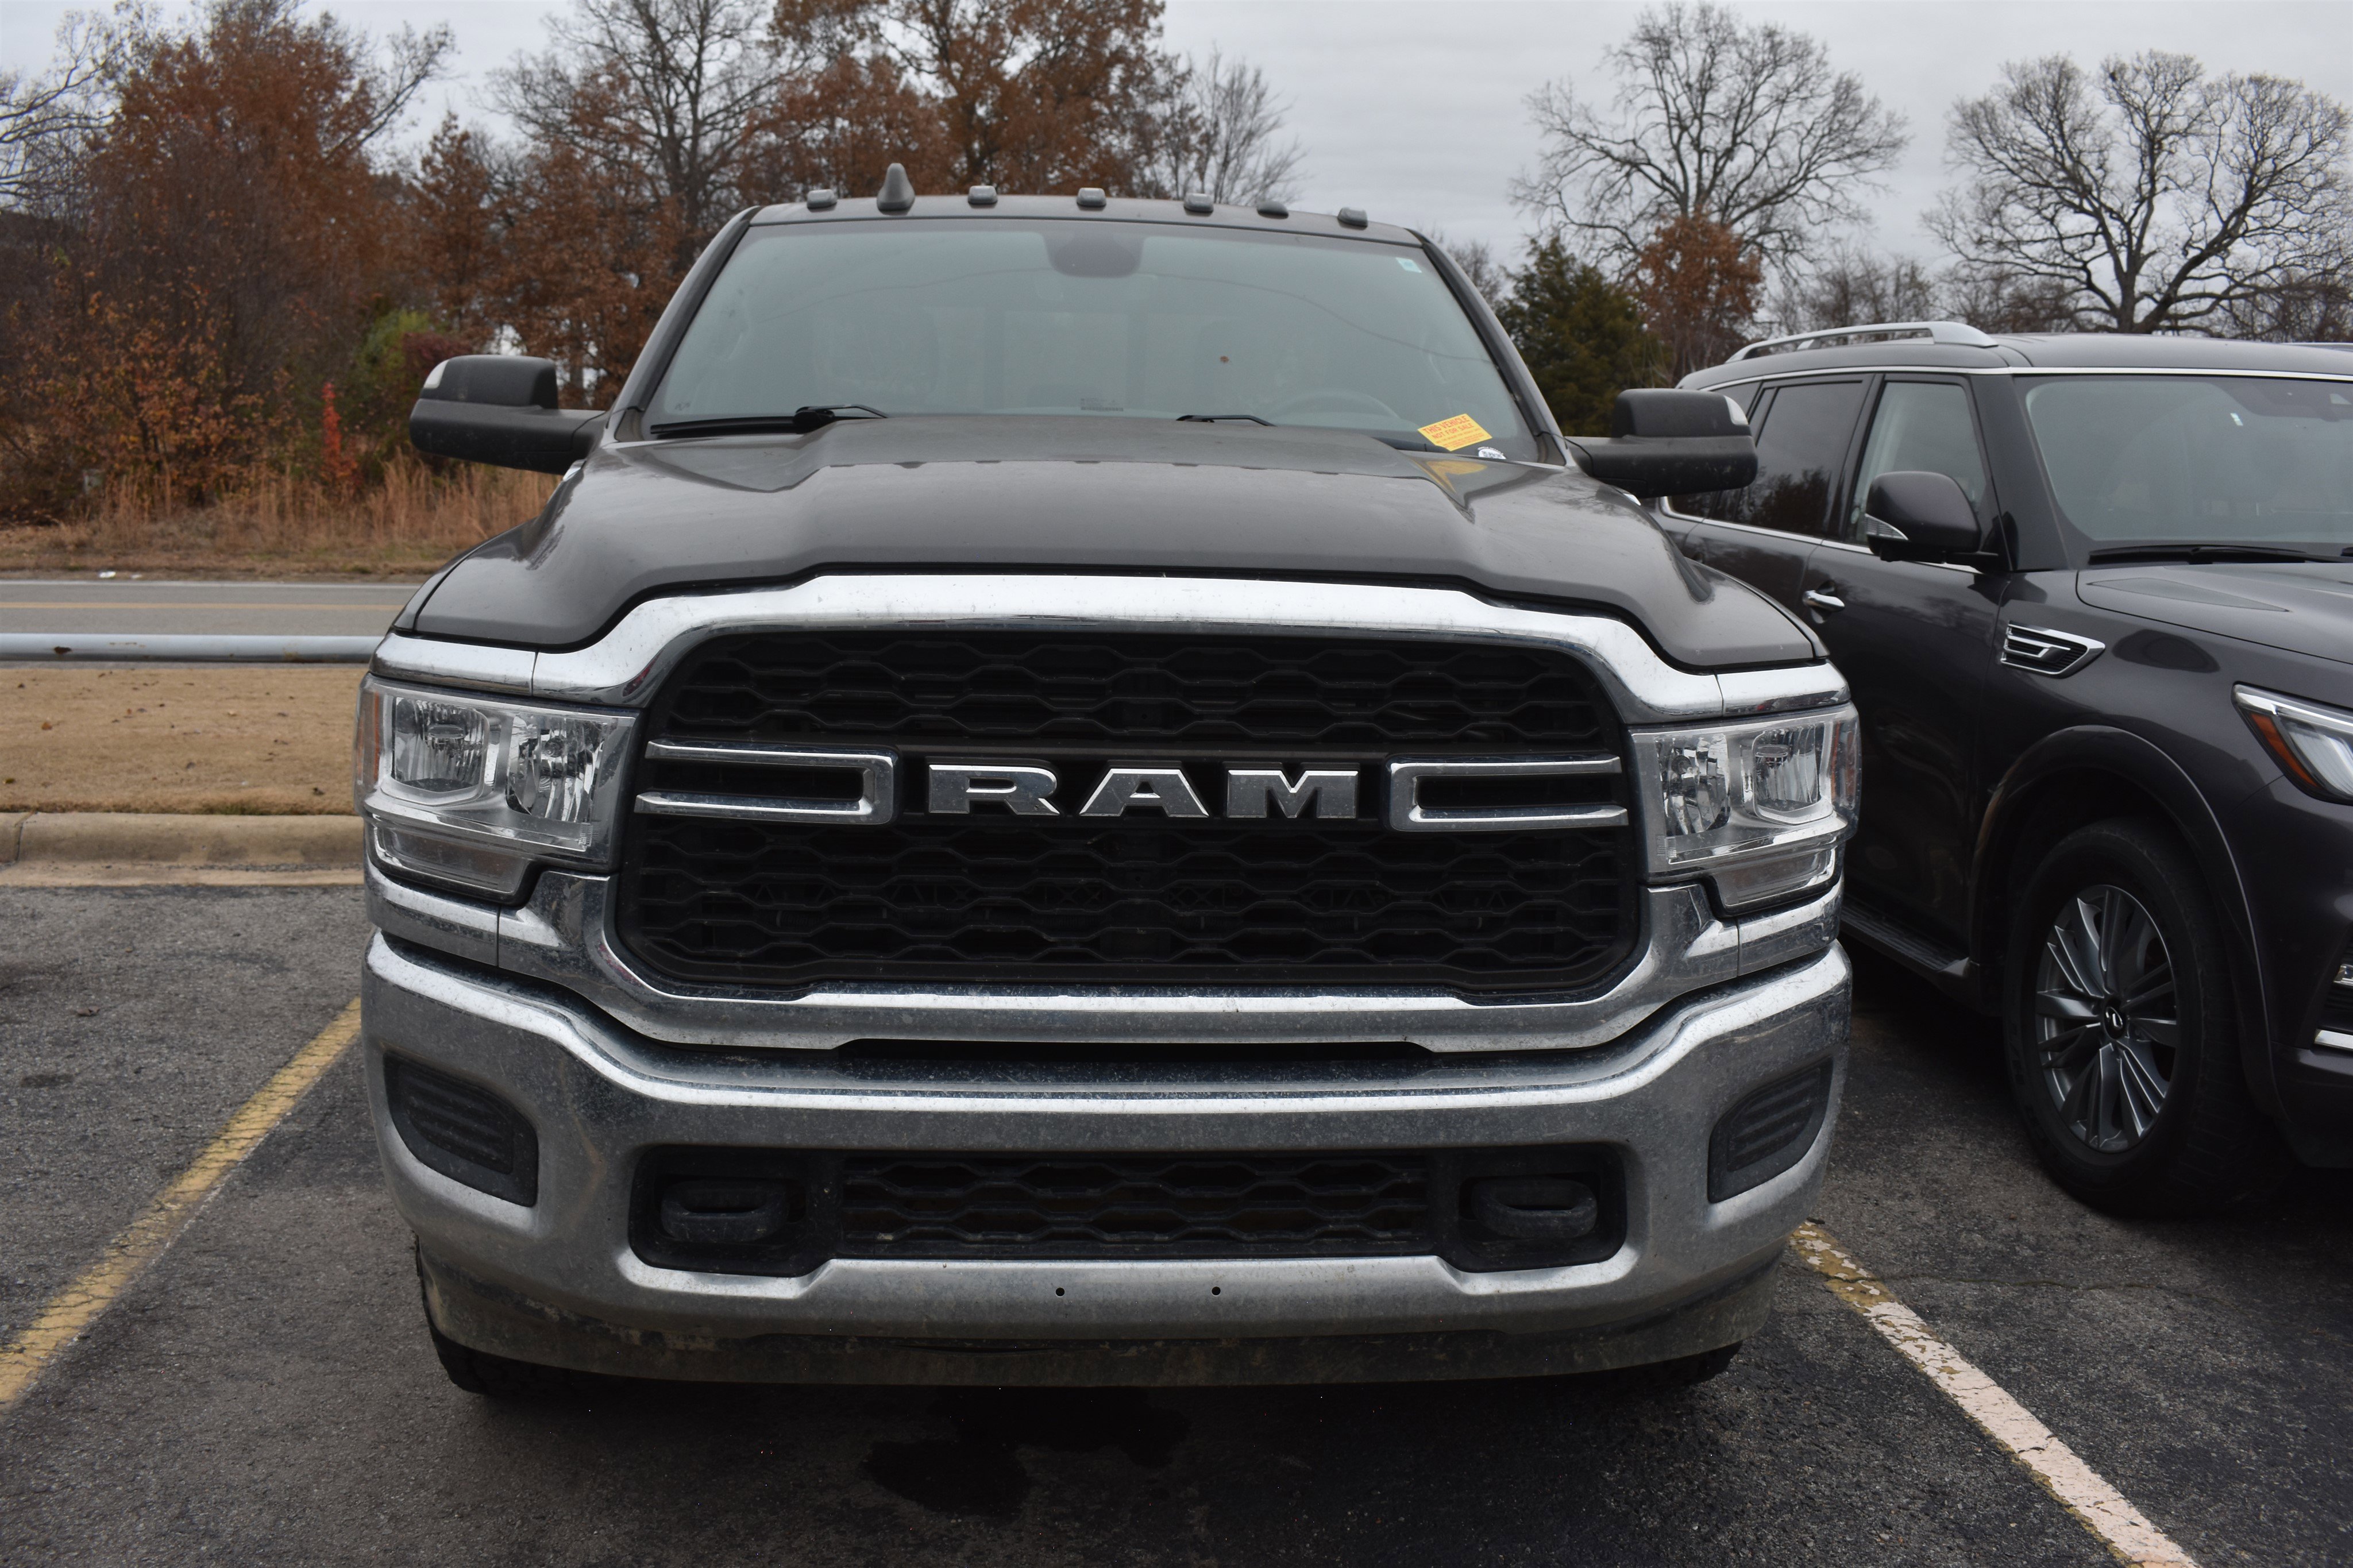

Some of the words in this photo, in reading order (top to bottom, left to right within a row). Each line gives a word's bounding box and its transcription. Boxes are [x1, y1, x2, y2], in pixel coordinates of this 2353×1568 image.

[1423, 424, 1441, 434] THIS
[1440, 416, 1470, 428] VEHICLE
[1458, 423, 1474, 431] SALE
[928, 763, 1360, 818] RAM
